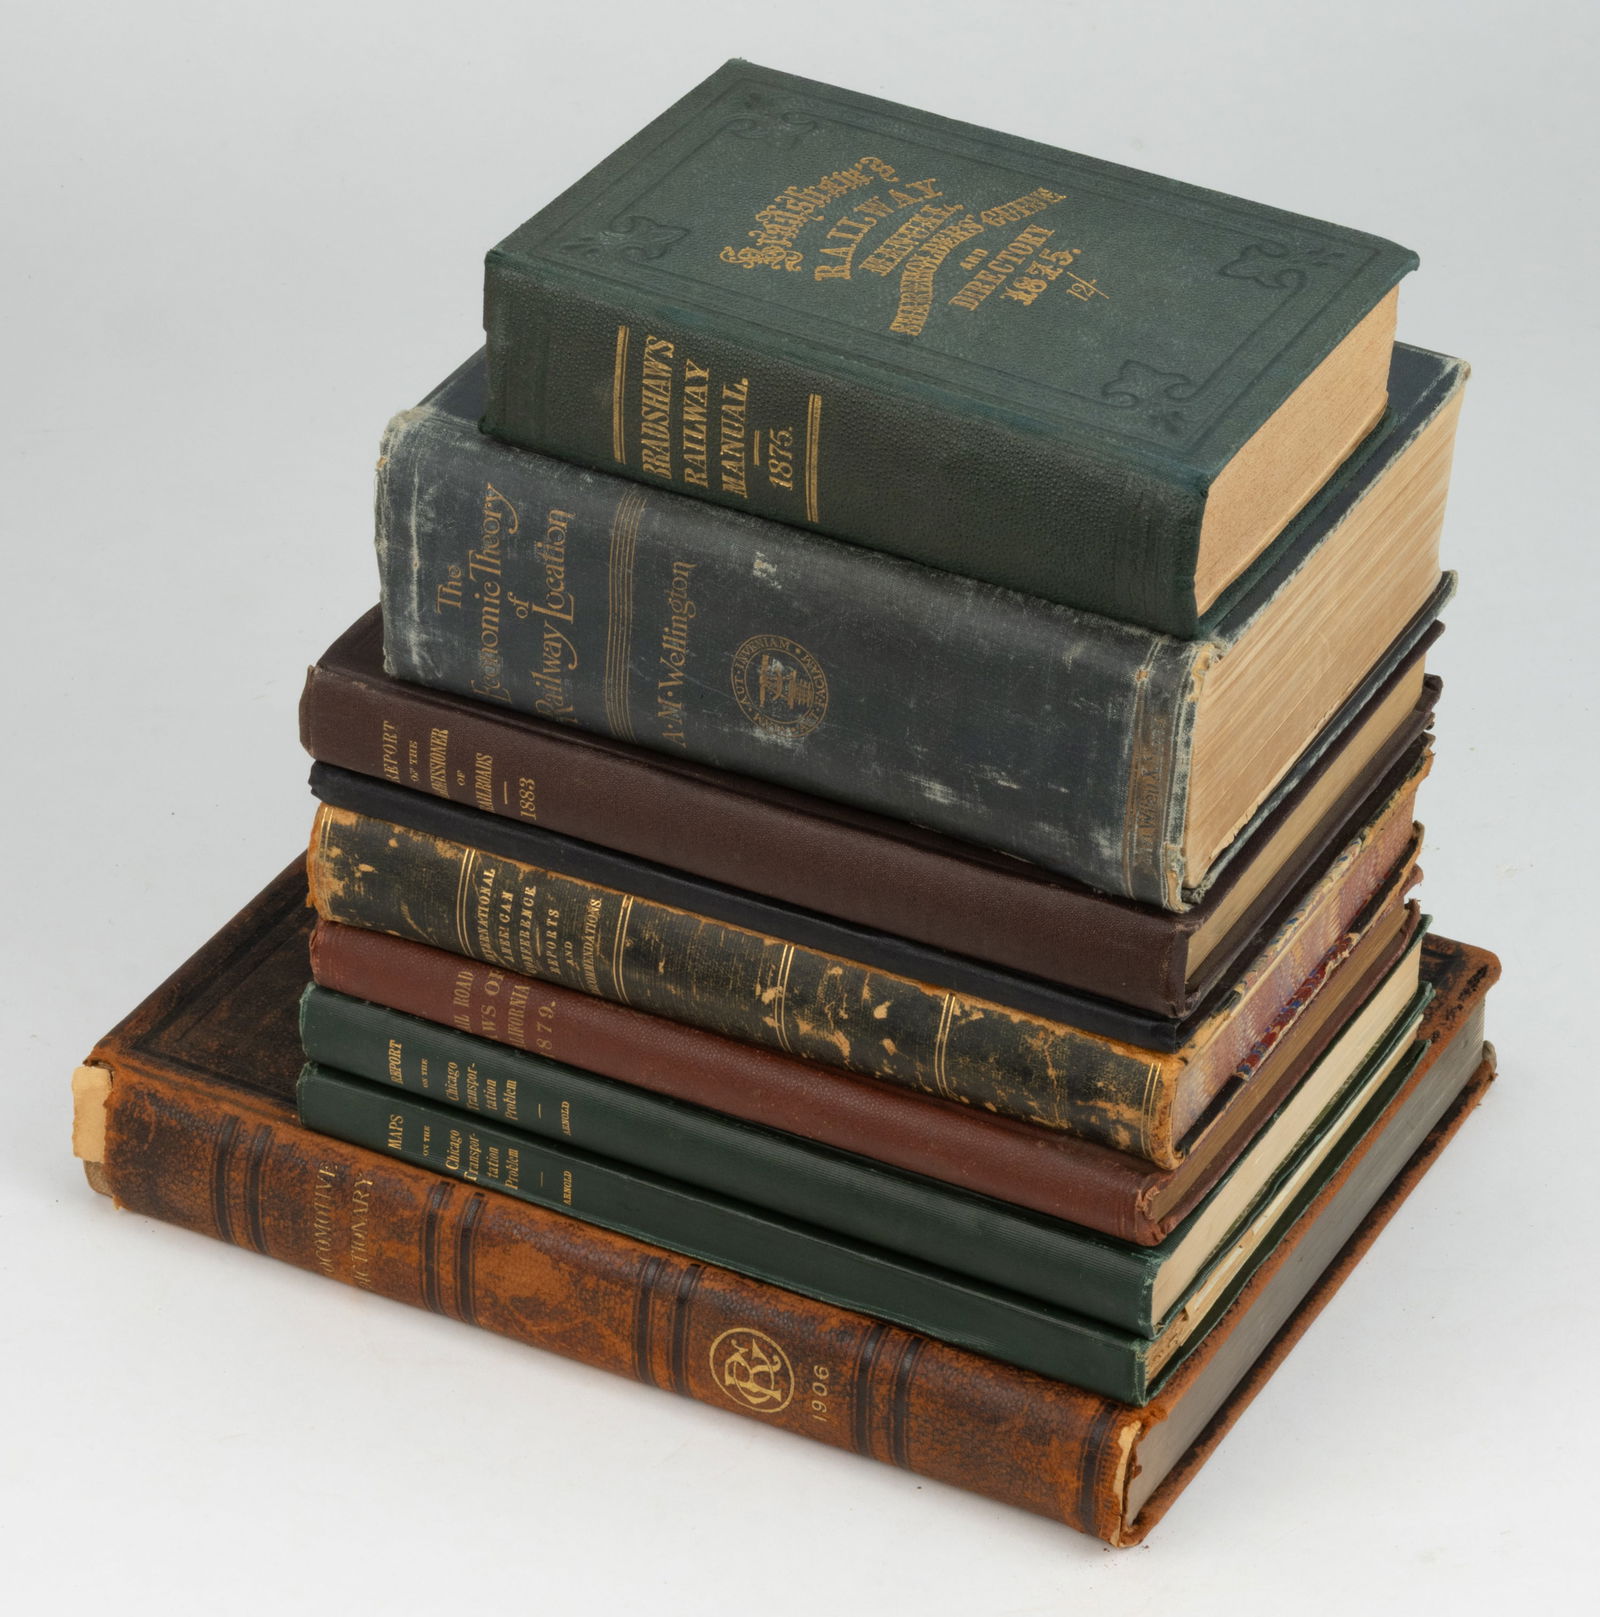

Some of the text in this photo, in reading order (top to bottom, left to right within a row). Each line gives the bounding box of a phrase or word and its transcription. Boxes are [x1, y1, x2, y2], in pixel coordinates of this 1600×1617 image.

[814, 178, 944, 281] RAILWAY
[948, 223, 1056, 311] DIRECTORY
[959, 247, 989, 271] AND
[640, 335, 675, 480] BRADSHAW'S
[682, 358, 709, 488] RAILWAY
[720, 377, 749, 498] MANUAL.
[768, 426, 793, 491] 1875.
[434, 564, 463, 615] The
[468, 482, 519, 705] Economic Theory
[507, 591, 530, 619] of
[531, 508, 578, 725] Railway Location
[382, 720, 400, 783] REPORT
[408, 740, 419, 765] THE
[456, 769, 466, 786] OF
[519, 776, 537, 821] 1883
[564, 940, 575, 967] AND
[454, 970, 475, 1008] ROAD
[508, 984, 531, 1049] ALIFORNIA
[388, 1039, 404, 1084] REPORT
[420, 1057, 429, 1077] THE
[444, 1061, 460, 1102] Chicago
[484, 1078, 498, 1111] tation
[502, 1079, 519, 1121] Problem
[387, 1114, 404, 1151] MAPS
[560, 1100, 572, 1137] ARNOLD
[422, 1125, 431, 1157] ON THE
[445, 1129, 463, 1171] Chicago
[463, 1131, 483, 1183] Transpor-
[485, 1145, 500, 1179] tation
[504, 1148, 520, 1191] Problem
[562, 1170, 574, 1206] ARNOLD
[312, 1161, 339, 1274] OCOMOTIVE
[811, 1364, 830, 1422] 1906
